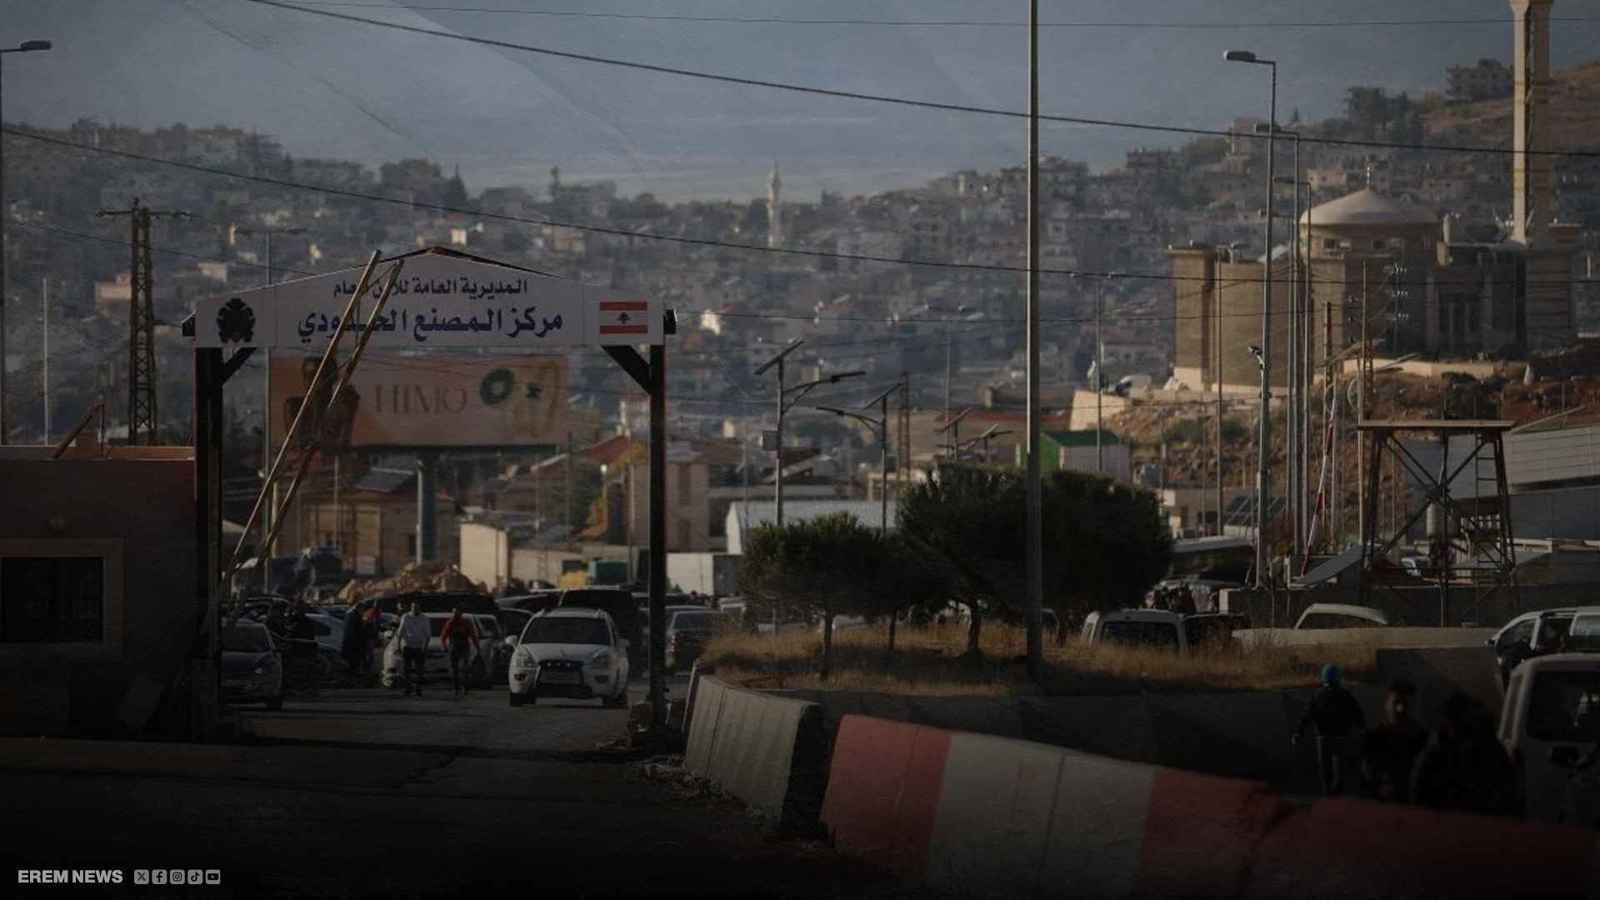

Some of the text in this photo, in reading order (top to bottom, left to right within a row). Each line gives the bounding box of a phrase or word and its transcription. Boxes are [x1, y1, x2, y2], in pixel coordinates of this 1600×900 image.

[333, 277, 528, 300] المديرية العامة للن عام
[414, 307, 502, 342] المصنع
[505, 306, 563, 338] مركز
